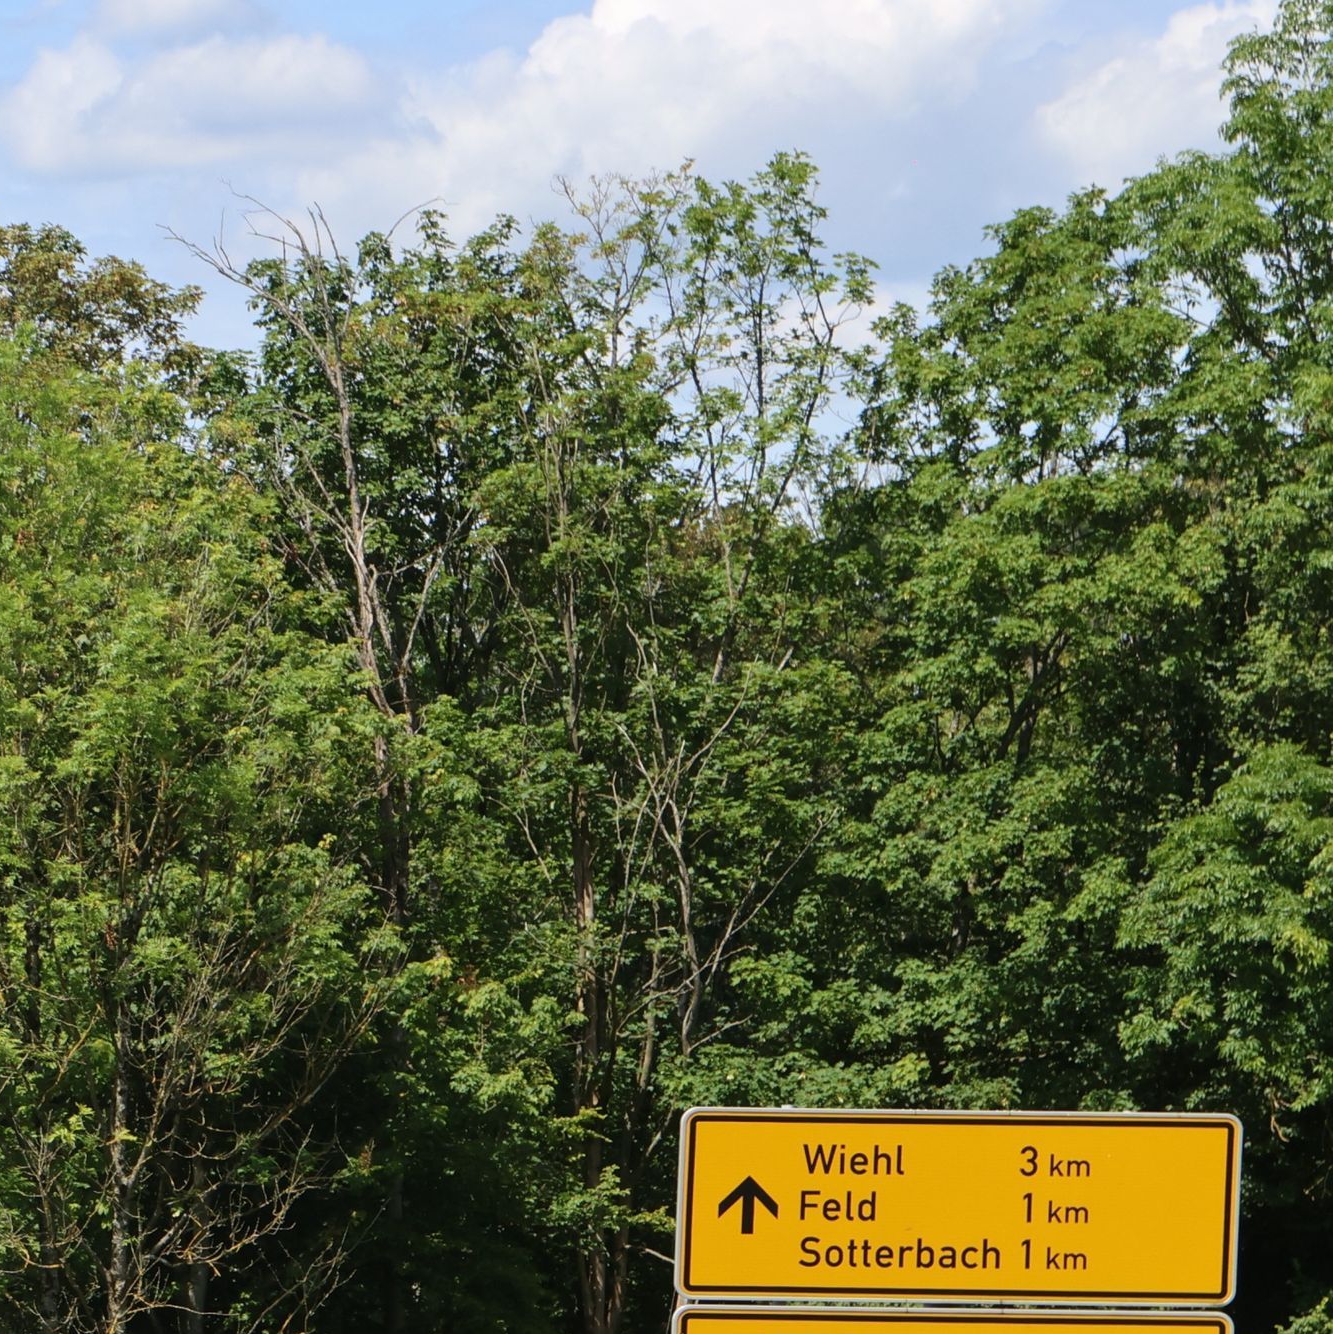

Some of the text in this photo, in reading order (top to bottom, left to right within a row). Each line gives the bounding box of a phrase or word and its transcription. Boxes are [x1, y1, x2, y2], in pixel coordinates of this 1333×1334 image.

[803, 1143, 1091, 1178] Wiehl 3 km
[799, 1190, 1089, 1224] Feld 1 km
[798, 1236, 1087, 1271] Sotterbach 1 km
